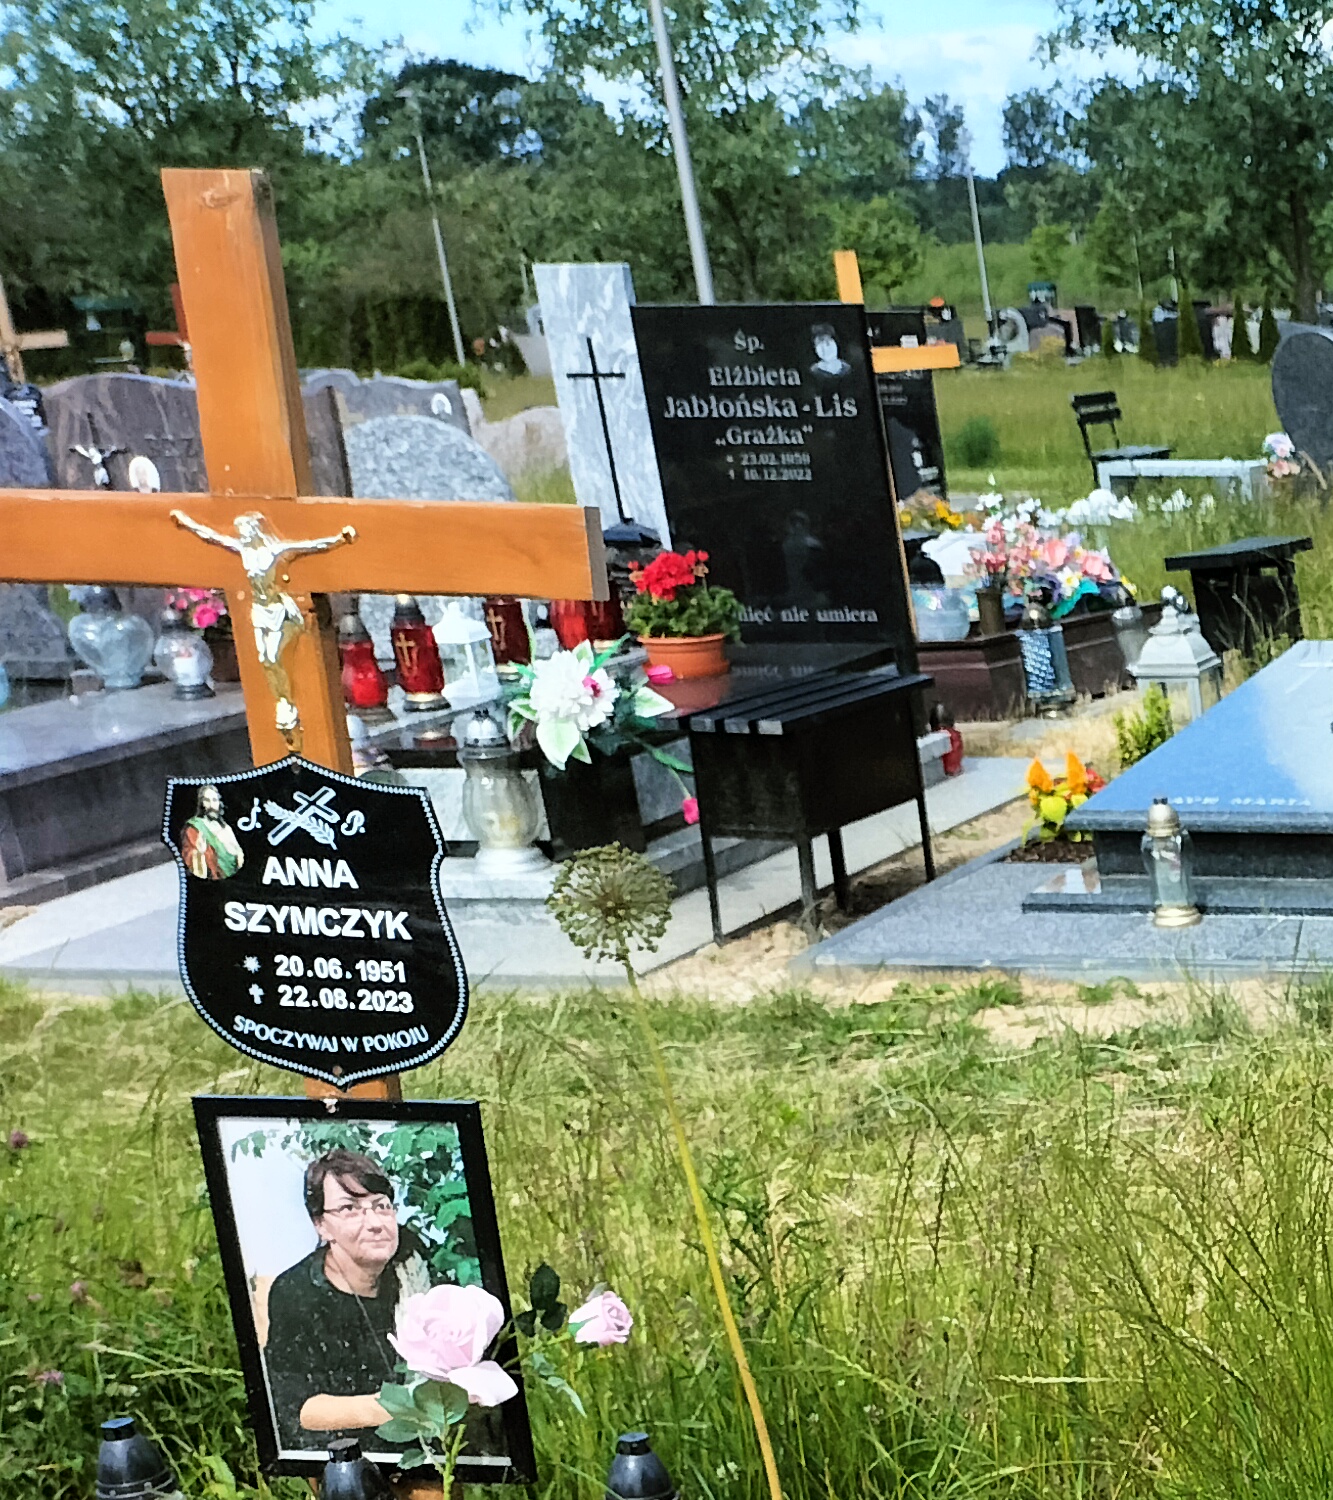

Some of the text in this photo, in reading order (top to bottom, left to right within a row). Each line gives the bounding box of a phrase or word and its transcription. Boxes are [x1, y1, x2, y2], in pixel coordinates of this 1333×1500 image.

[708, 365, 801, 386] Elżbieta
[780, 605, 810, 623] nie
[816, 605, 879, 623] umiera
[262, 855, 359, 889] ANNA
[224, 901, 413, 941] SZYMCZYK
[274, 954, 406, 983] 20.06.1951
[277, 984, 414, 1013] 22.08.2023
[233, 1015, 429, 1053] SPOCZYWAJ W POKOJU
